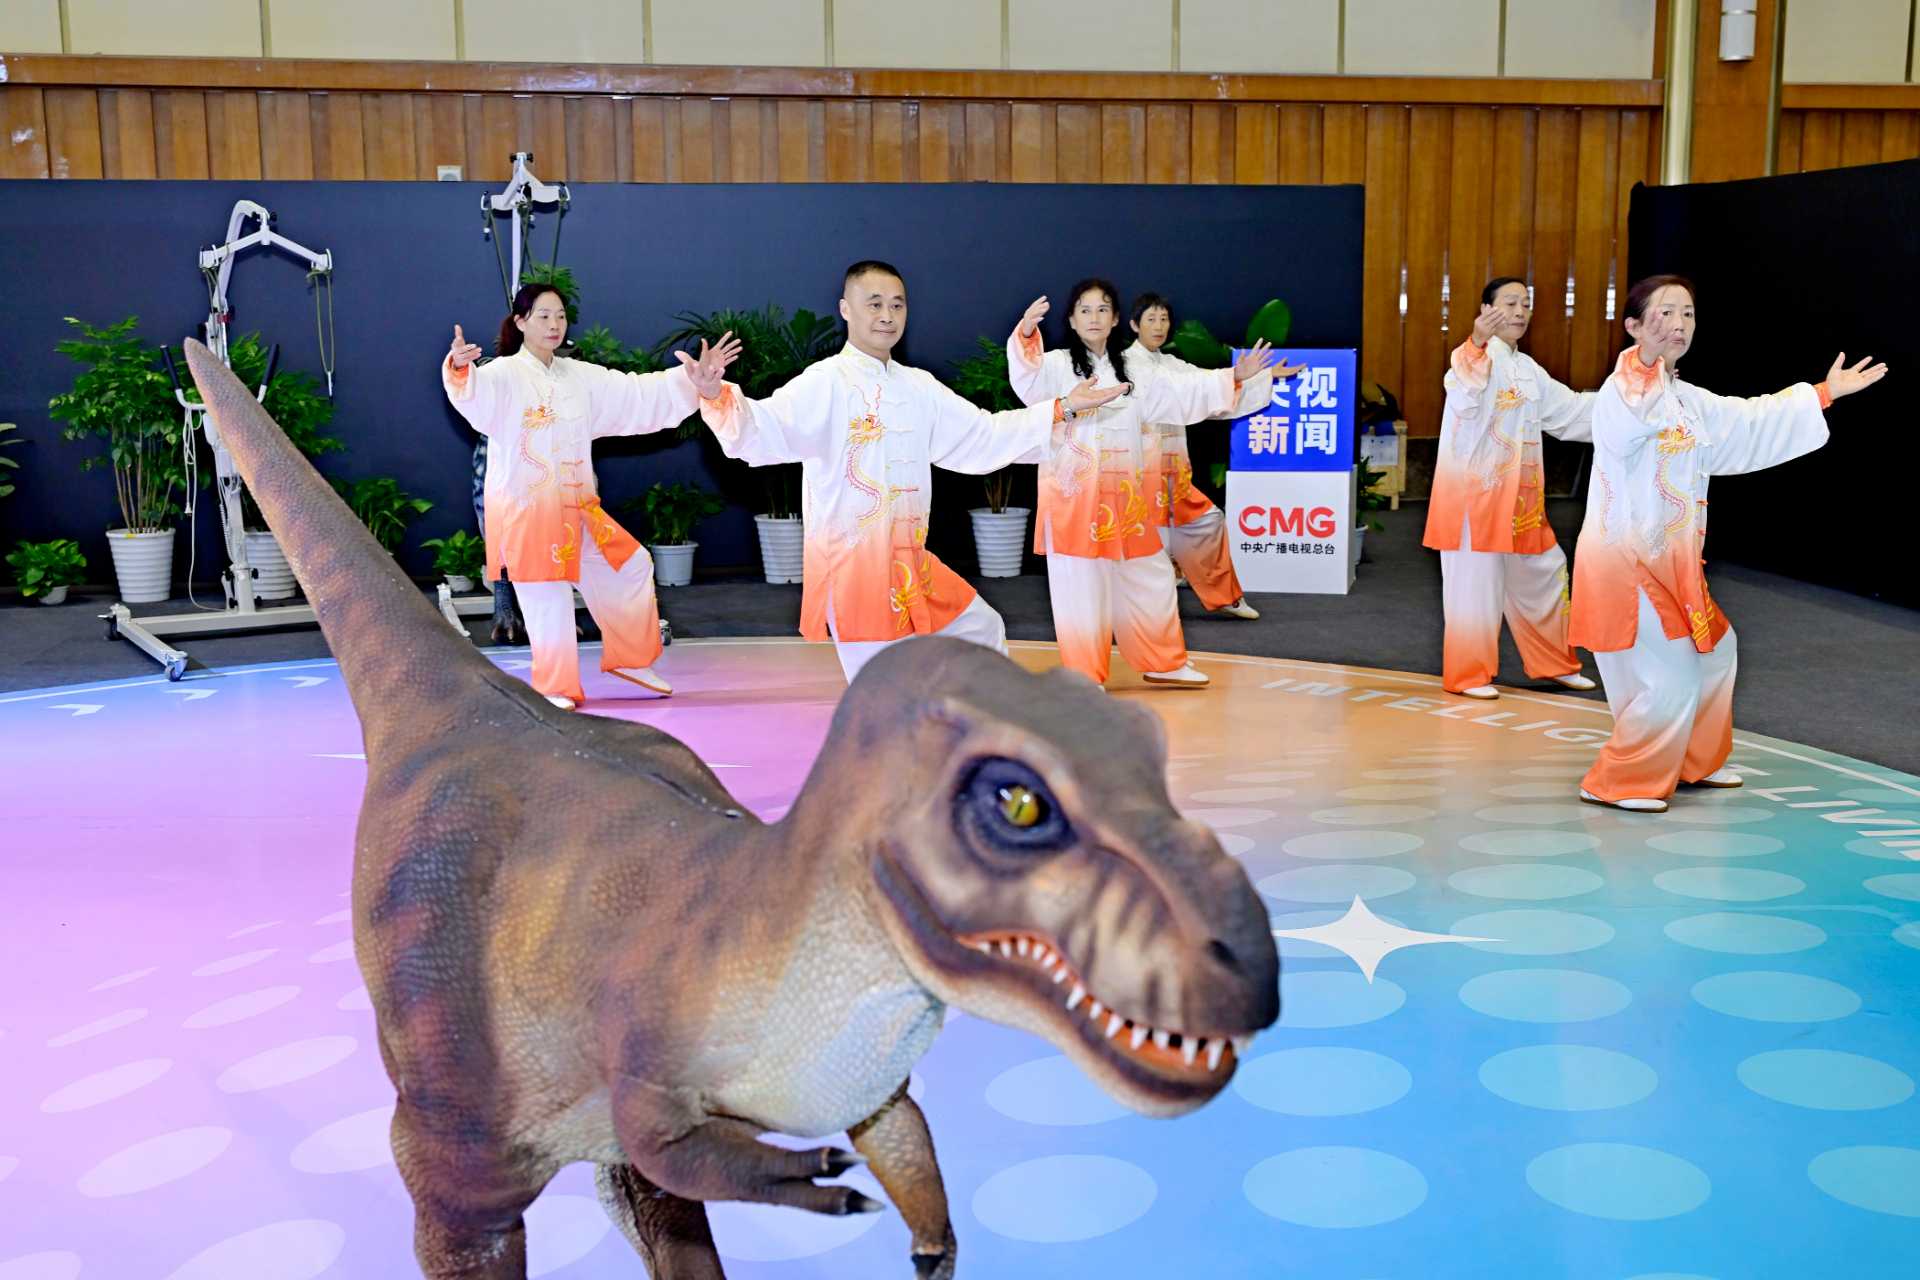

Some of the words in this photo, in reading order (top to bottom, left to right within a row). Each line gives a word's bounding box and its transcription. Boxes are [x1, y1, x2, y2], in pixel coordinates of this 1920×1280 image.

[1248, 414, 1337, 454] 新闻
[1238, 506, 1336, 538] CMG
[1240, 542, 1335, 555] 中央广播电视总台
